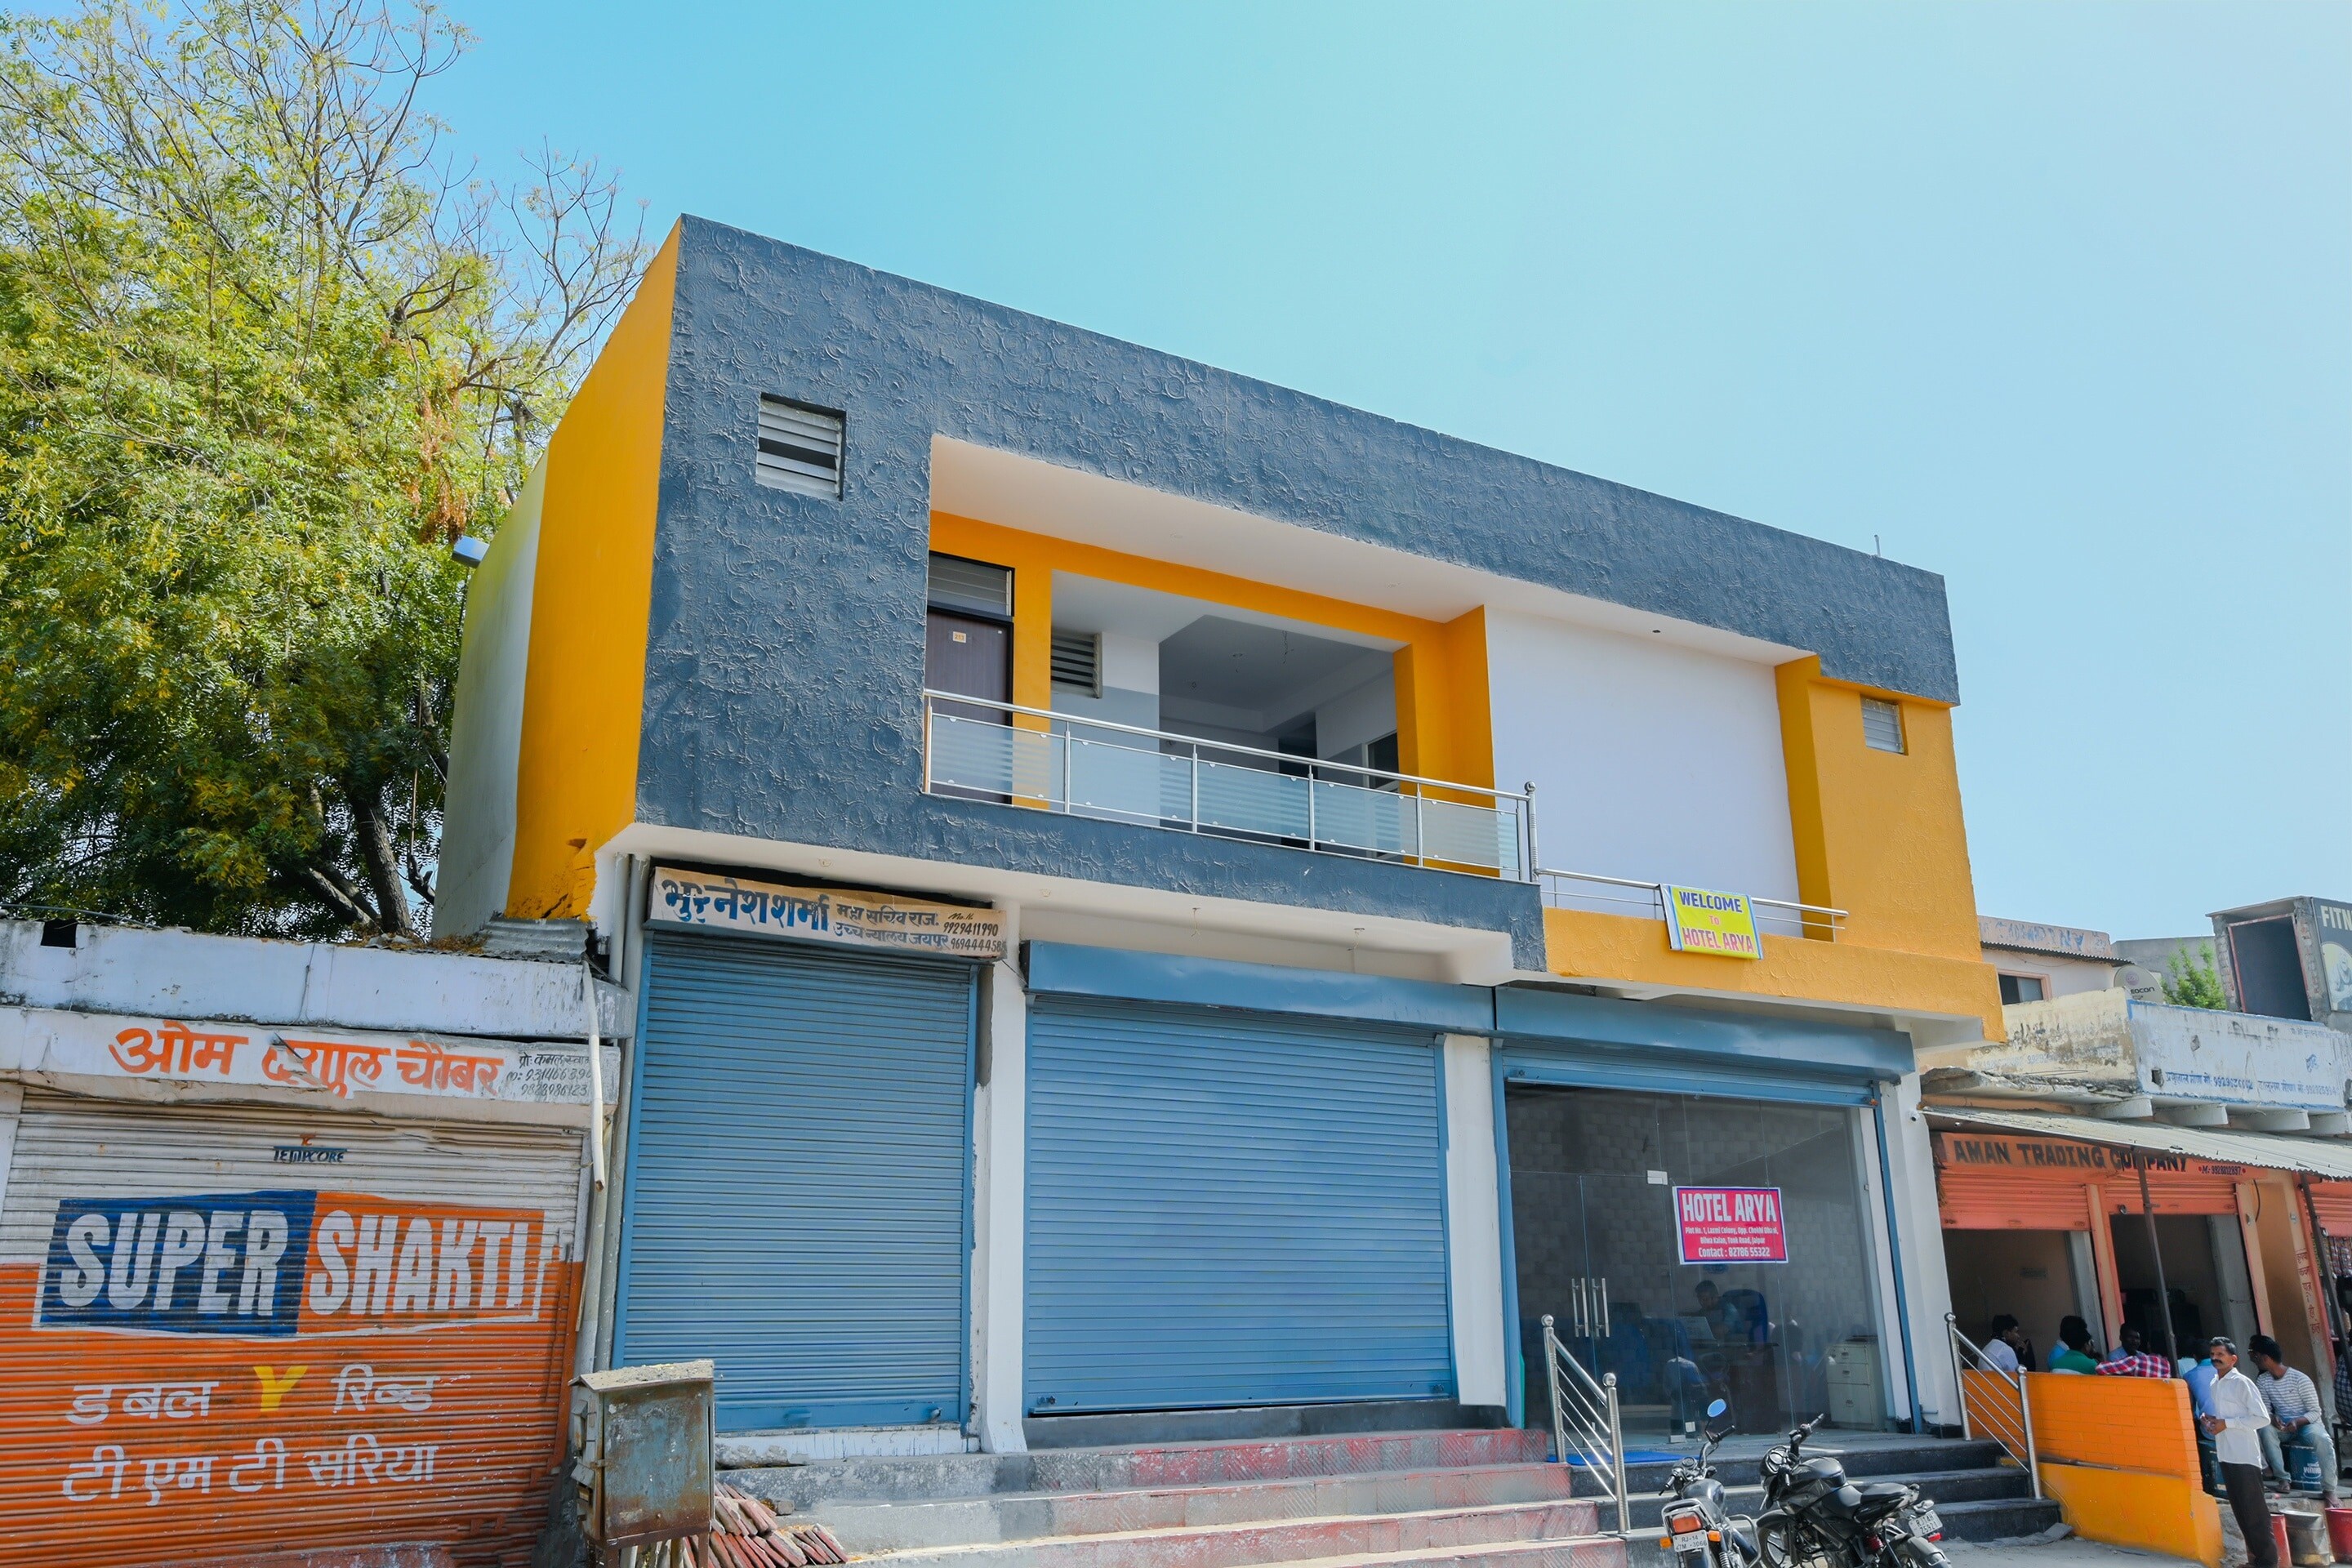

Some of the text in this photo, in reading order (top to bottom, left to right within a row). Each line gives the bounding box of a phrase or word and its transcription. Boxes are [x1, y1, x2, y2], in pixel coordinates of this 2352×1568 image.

[1679, 890, 1743, 913] WELCOME
[943, 921, 999, 937] 9929411990
[1682, 926, 1755, 954] HOTEL ARYA
[108, 1020, 249, 1076] ओम
[1953, 1140, 2012, 1164] AMAN
[2016, 1143, 2106, 1169] TRADING
[1682, 1193, 1778, 1223] HOTEL ARYA
[59, 1209, 529, 1316] SUPER SHAKTI
[1699, 1247, 1724, 1257] Contact
[1750, 1247, 1771, 1257] 55322
[65, 1380, 220, 1424] डबल
[253, 1365, 309, 1413] Y
[62, 1445, 132, 1502] टी
[301, 1434, 440, 1488] सरिया
